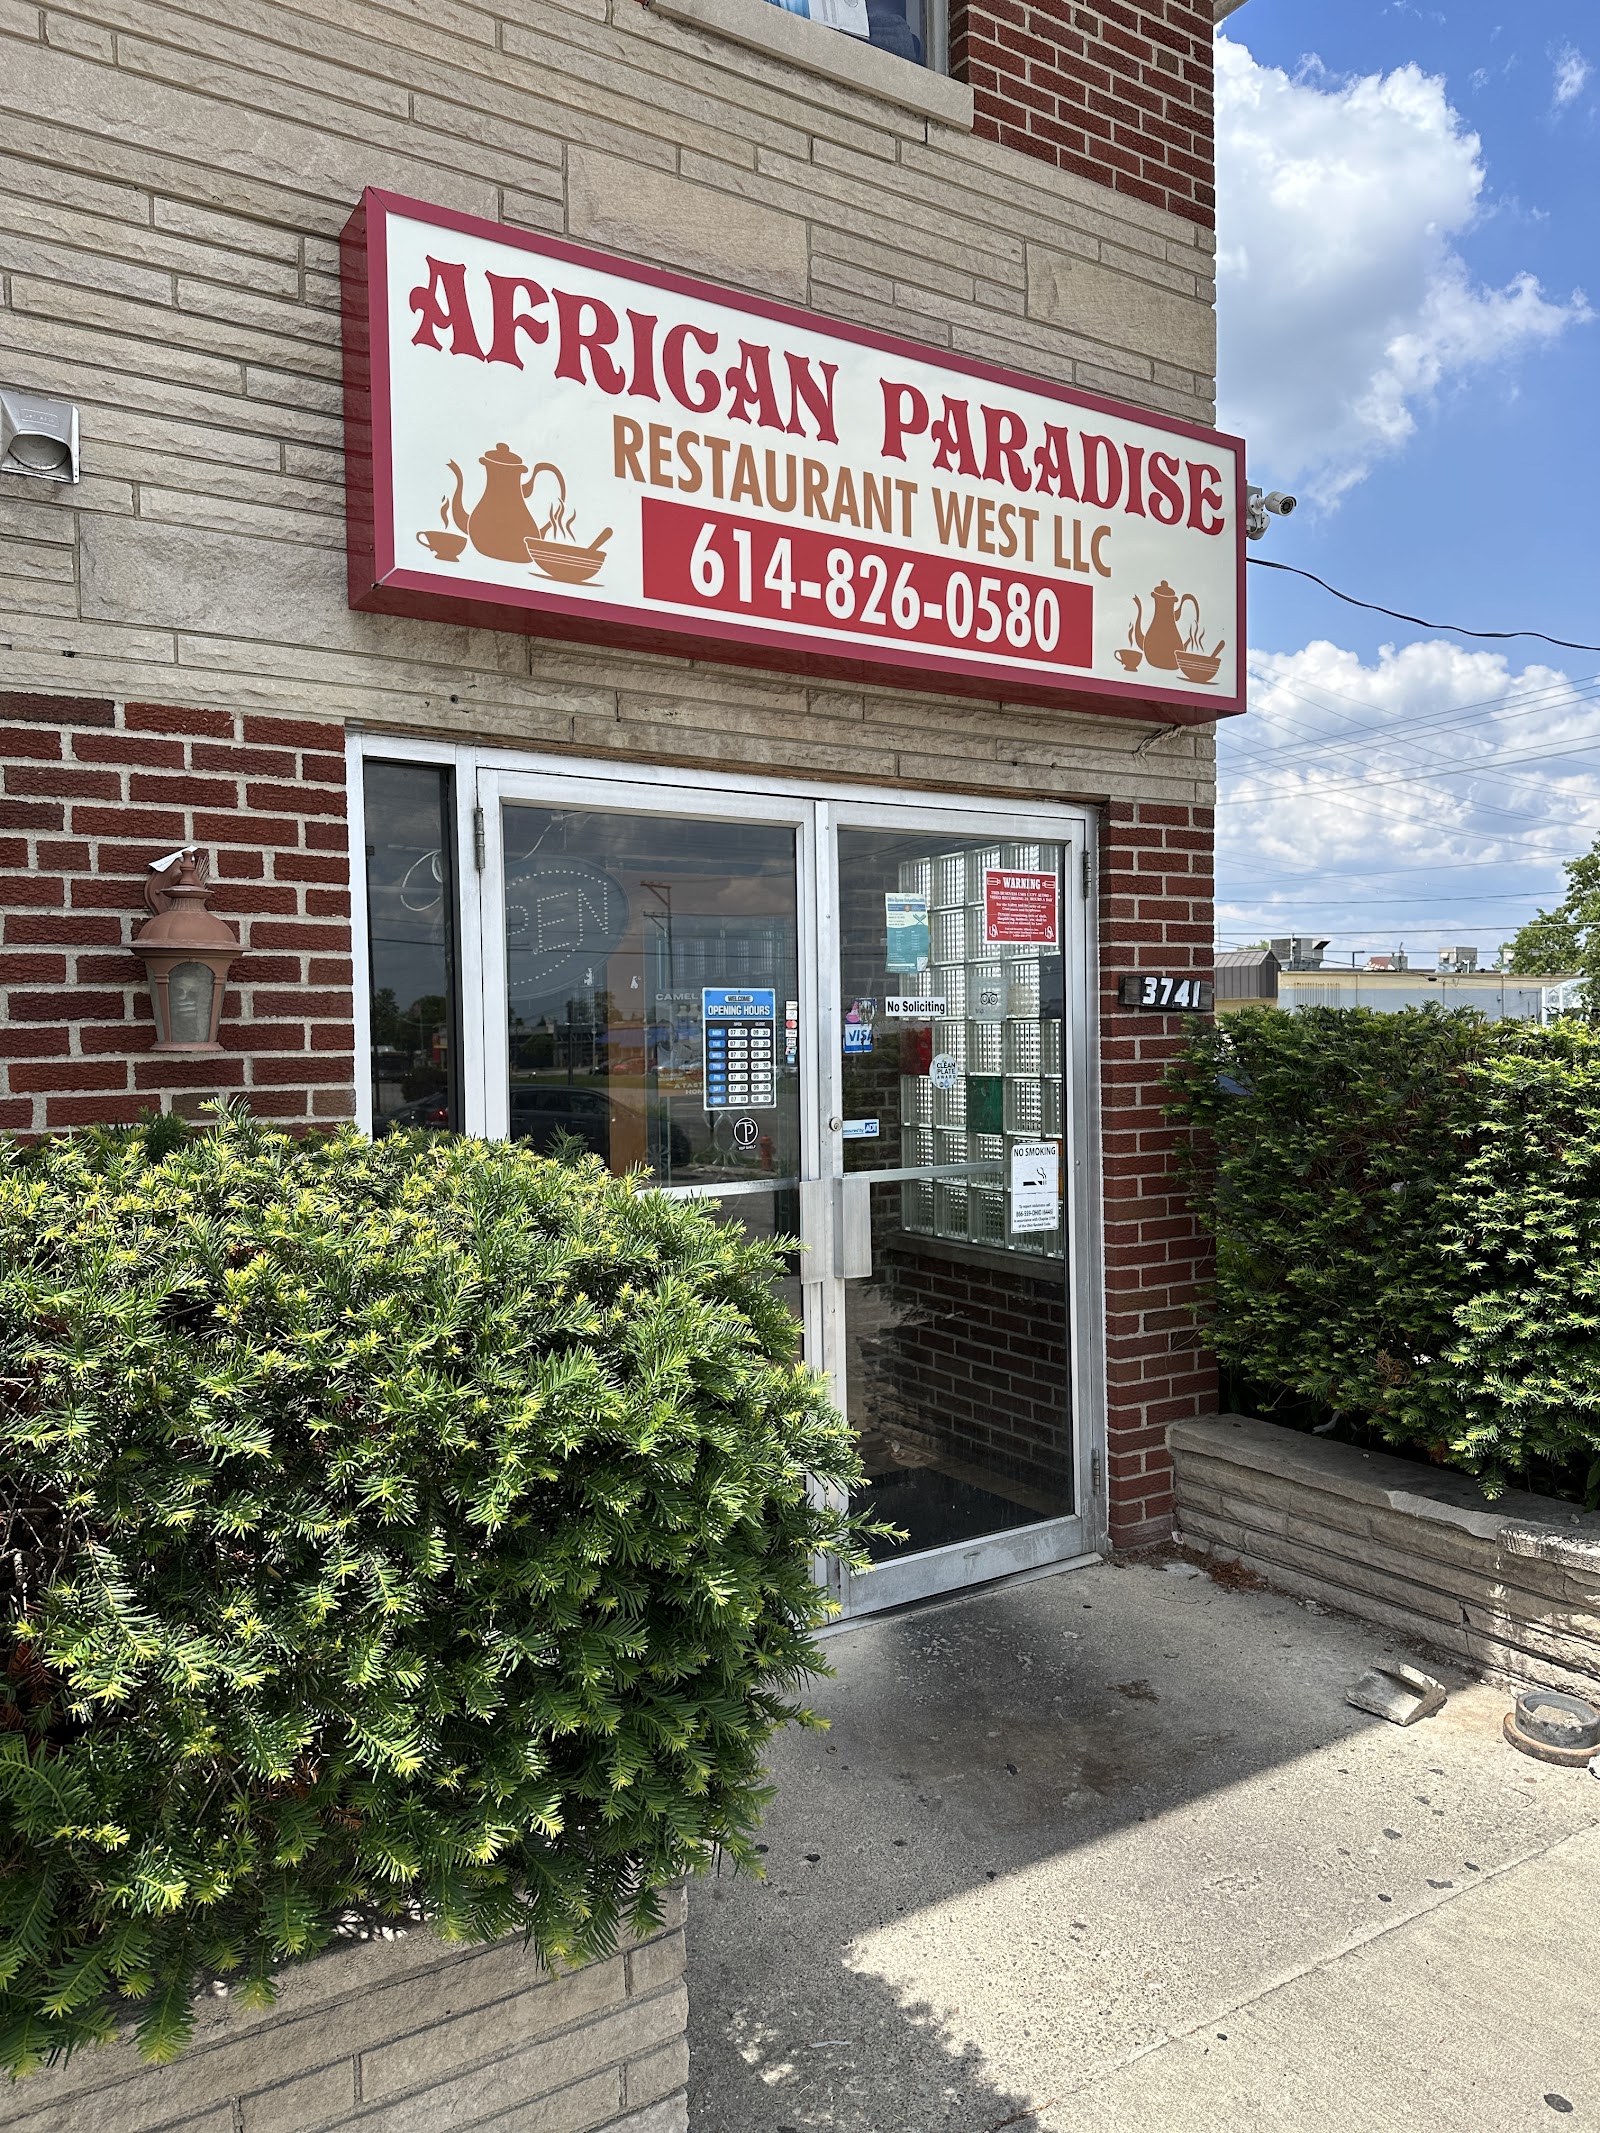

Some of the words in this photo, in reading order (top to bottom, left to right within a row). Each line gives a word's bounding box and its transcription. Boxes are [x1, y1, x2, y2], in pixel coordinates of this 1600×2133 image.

[410, 255, 839, 445] AFRICAN
[880, 376, 1225, 536] PARADISE
[613, 414, 918, 538] RESTAURANT
[934, 495, 1039, 563] WEST
[1053, 515, 1112, 577] LLC
[689, 523, 1061, 653] 614-826-0580
[1003, 877, 1040, 889] WARNING
[656, 993, 698, 1001] CAMEL
[1142, 977, 1200, 1007] 3741
[708, 1005, 742, 1015] OPENING
[744, 1005, 770, 1015] HOURS
[887, 1001, 899, 1012] No
[903, 1001, 945, 1014] Soliciting
[849, 1030, 872, 1041] VISA
[1014, 1148, 1024, 1156] NO
[1025, 1147, 1055, 1156] SMOKING
